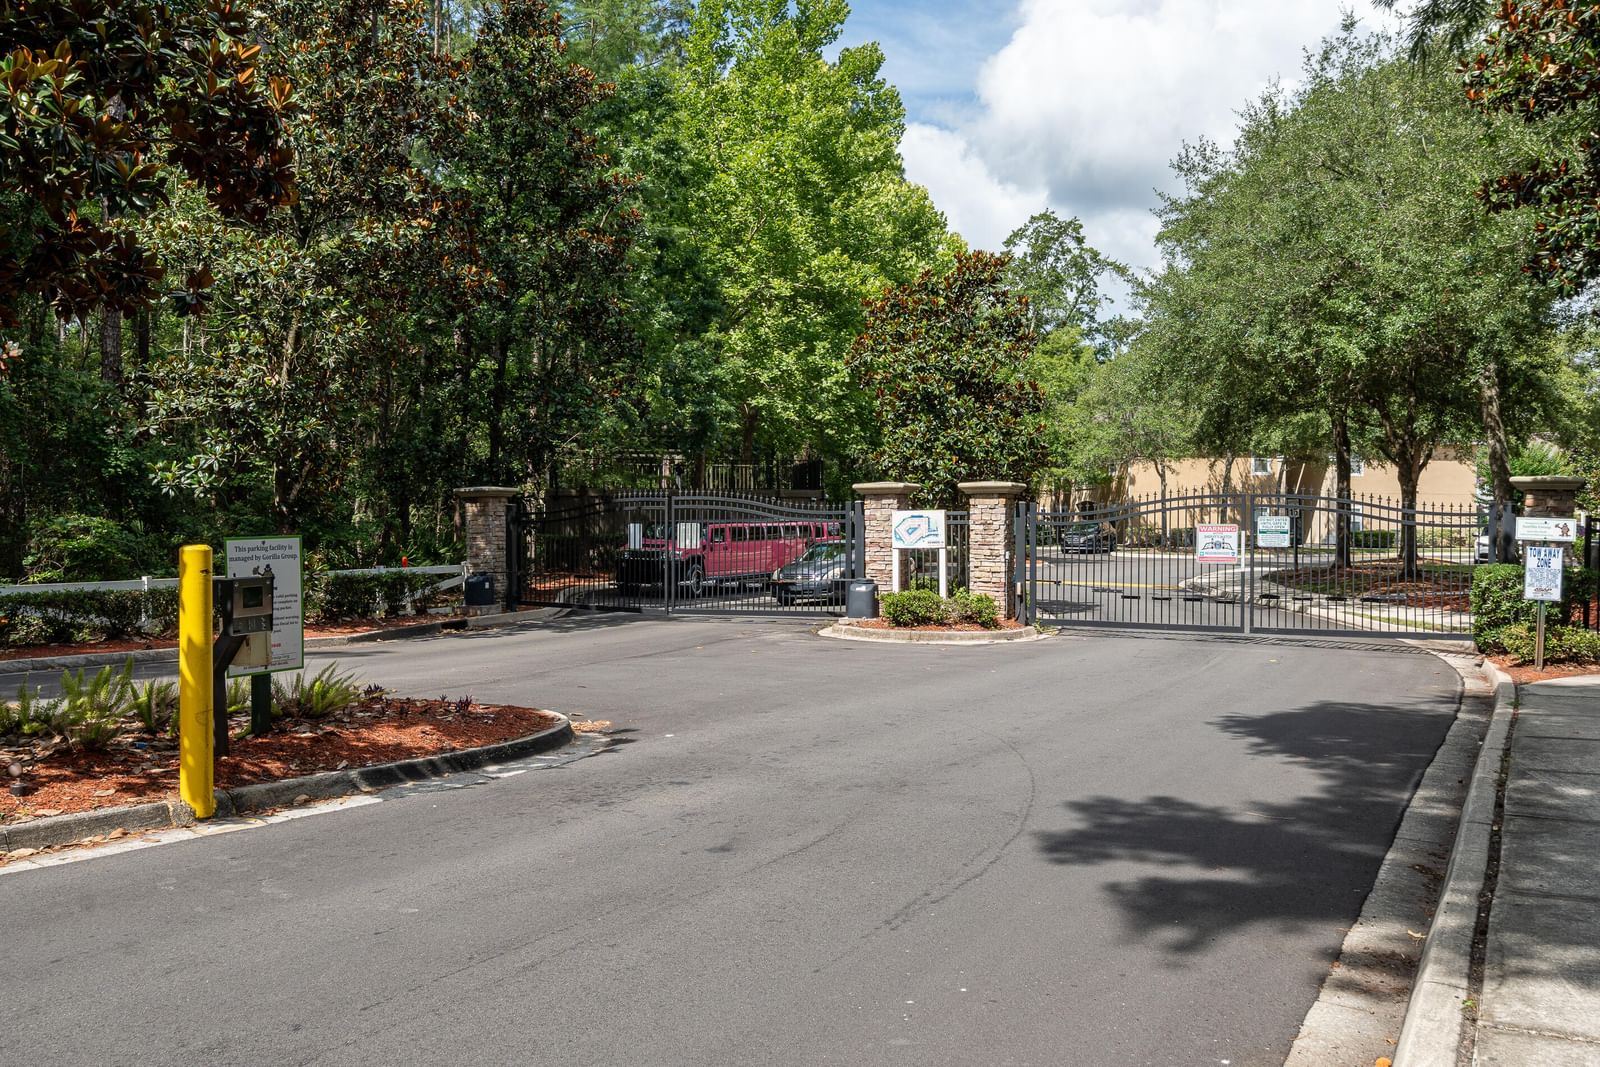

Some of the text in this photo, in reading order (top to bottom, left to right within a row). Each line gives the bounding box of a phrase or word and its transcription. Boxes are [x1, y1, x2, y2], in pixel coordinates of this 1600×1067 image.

[247, 544, 268, 553] parking
[269, 543, 287, 552] facility
[1529, 547, 1560, 559] TOW AWAY
[229, 554, 254, 562] managed
[254, 554, 261, 562] by
[262, 553, 280, 561] Gorilla
[1537, 558, 1552, 568] ZONE
